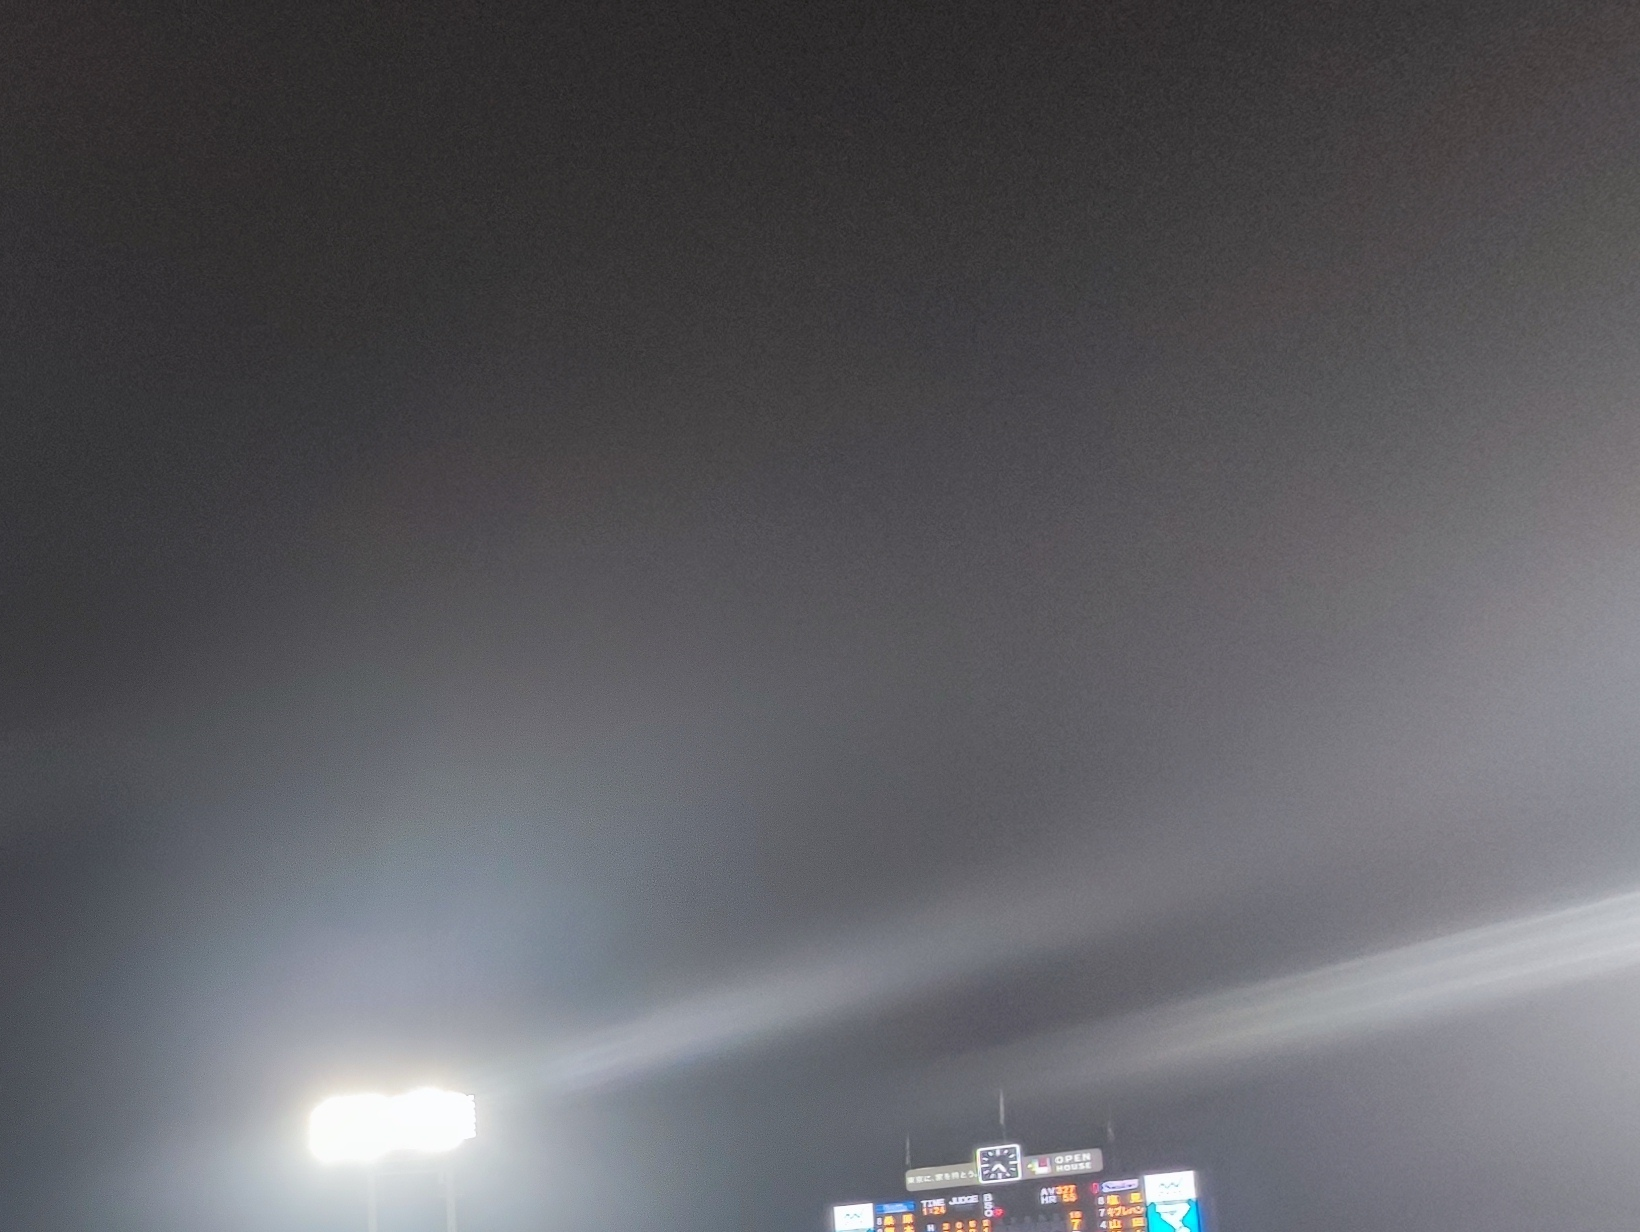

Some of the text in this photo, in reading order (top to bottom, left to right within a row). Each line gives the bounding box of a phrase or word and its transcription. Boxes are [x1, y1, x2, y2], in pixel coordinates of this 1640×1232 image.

[1055, 1153, 1092, 1164] OPEN
[1056, 1162, 1092, 1172] HOUSE
[920, 1198, 946, 1207] TIME
[949, 1195, 979, 1205] JUDGE
[1041, 1195, 1057, 1204] HR
